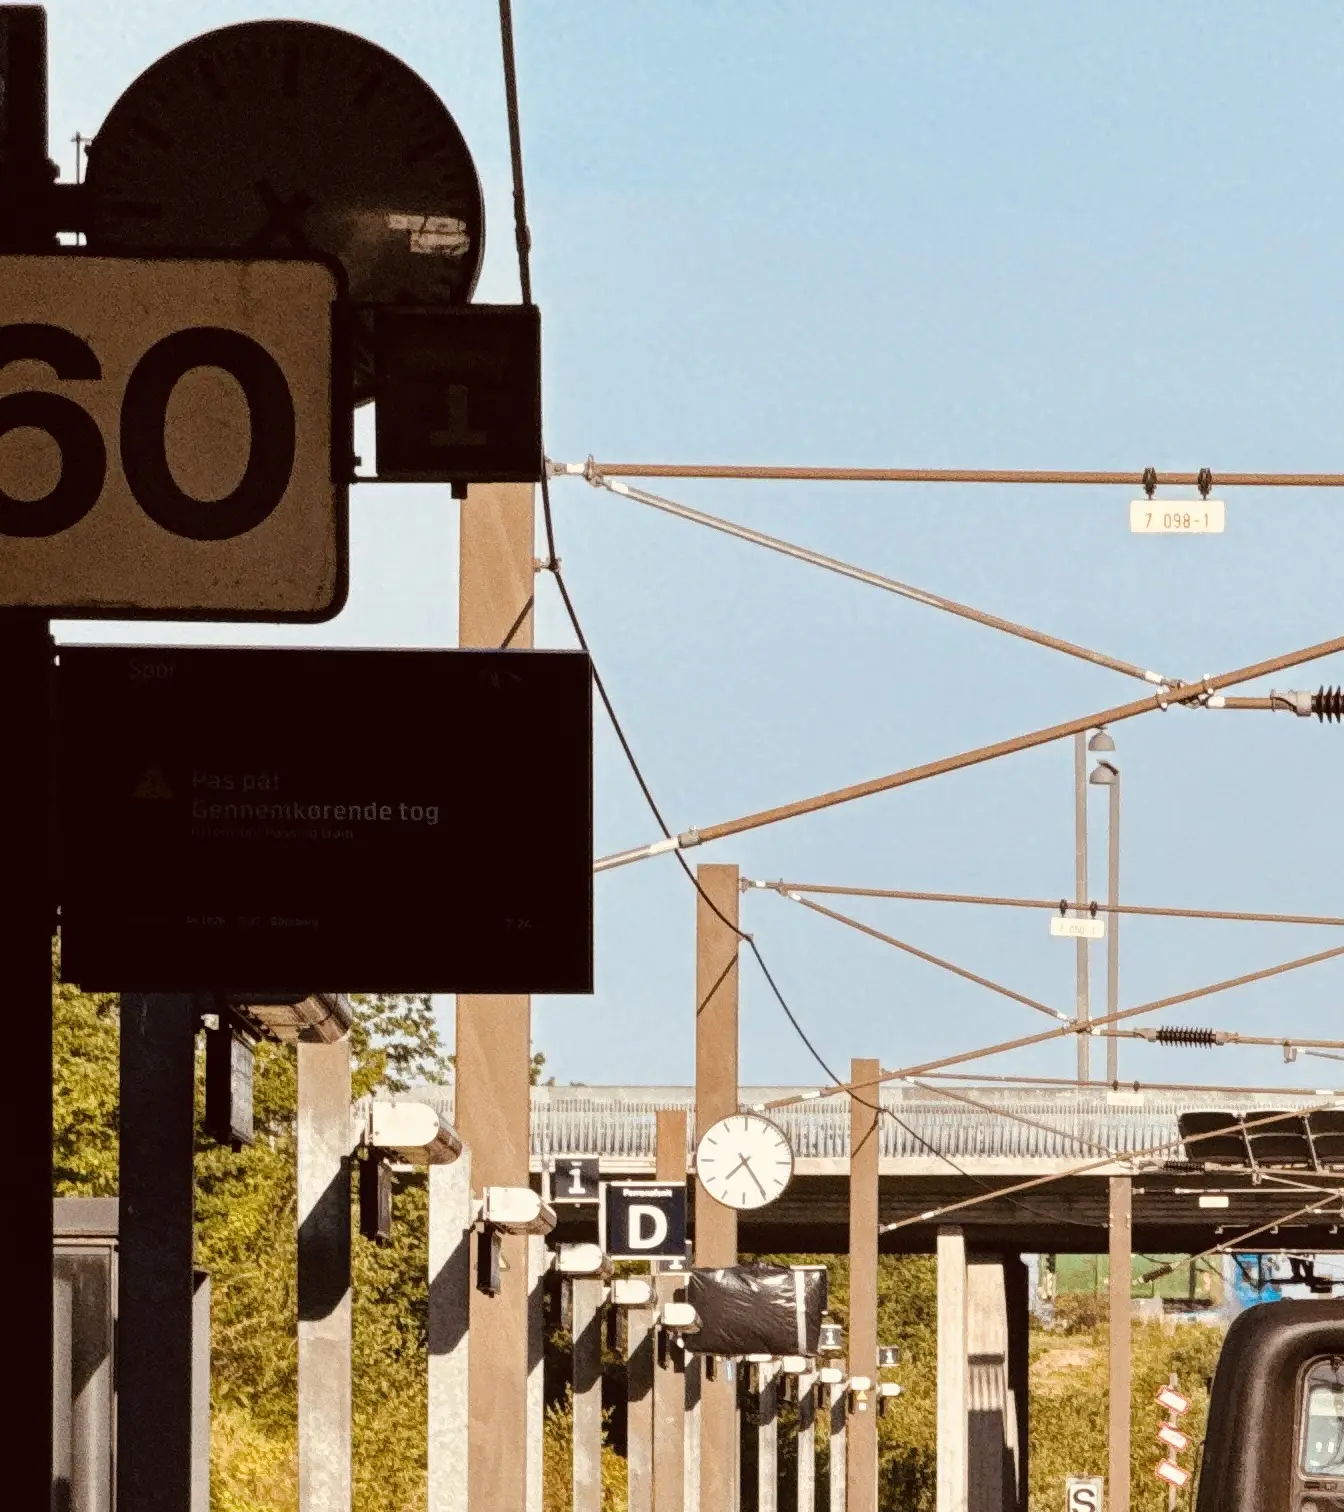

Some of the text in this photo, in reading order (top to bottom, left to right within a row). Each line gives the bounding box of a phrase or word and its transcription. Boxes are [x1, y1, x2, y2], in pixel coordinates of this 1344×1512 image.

[398, 802, 440, 826] tog
[568, 1169, 586, 1195] 1
[628, 1205, 668, 1249] D
